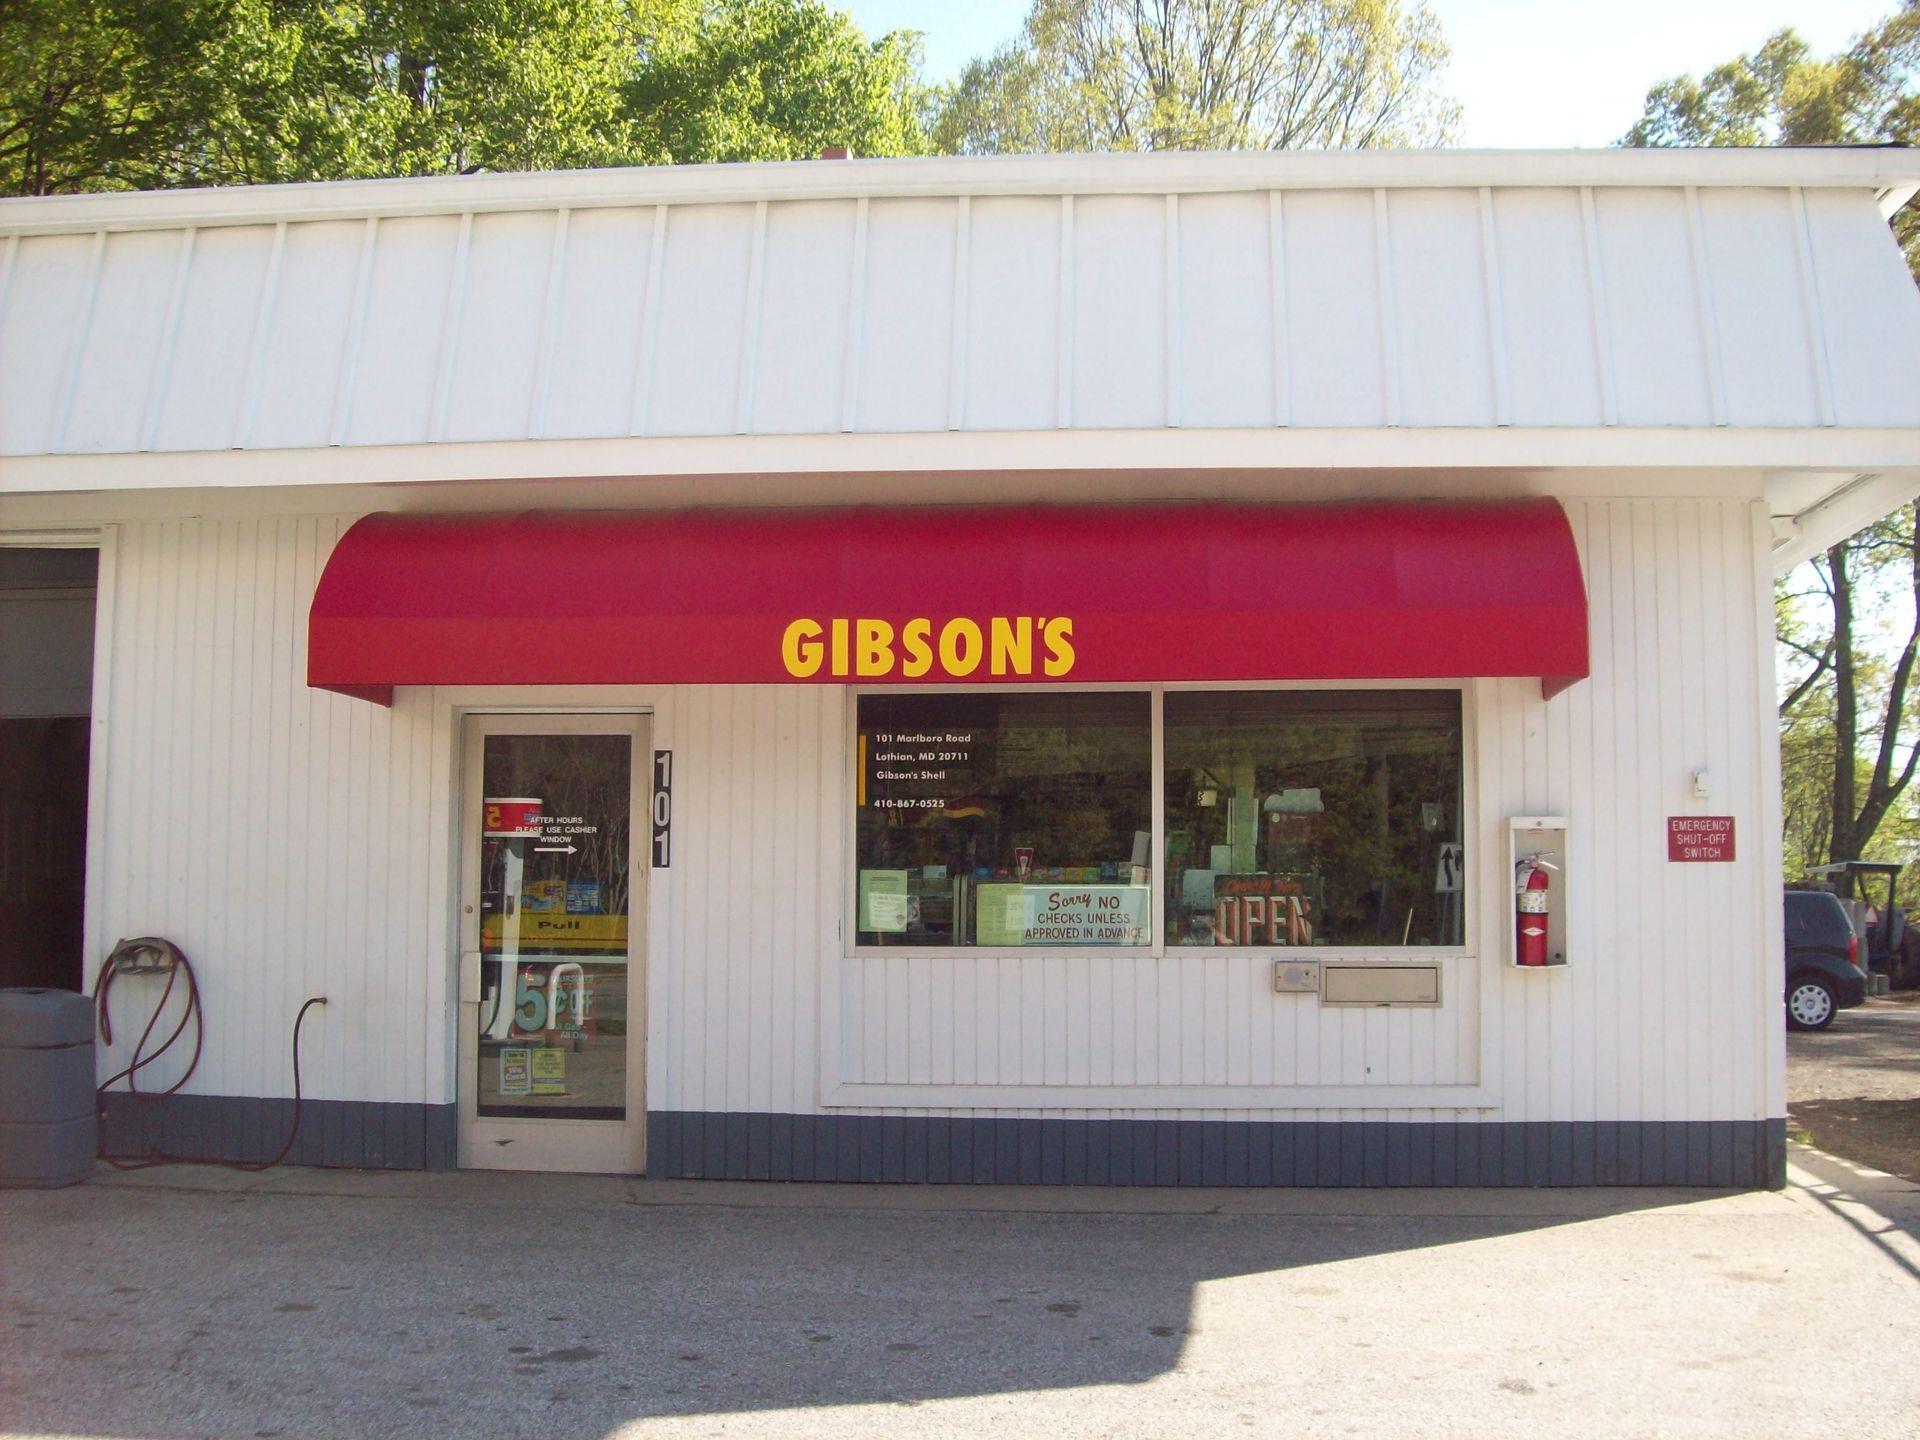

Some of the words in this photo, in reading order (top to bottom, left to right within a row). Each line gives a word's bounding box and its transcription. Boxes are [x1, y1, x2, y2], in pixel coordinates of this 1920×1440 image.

[782, 617, 1075, 677] GIBSON'S
[876, 735, 893, 743] 101
[896, 734, 942, 743] Marlboro
[945, 734, 971, 743] Road
[875, 752, 916, 762] Lothian,
[918, 752, 935, 761] MD
[938, 752, 968, 761] 20711
[876, 771, 918, 779] Gibson's
[921, 770, 945, 779] Shell
[653, 751, 670, 867] 101
[874, 799, 945, 808] 410-867-0525
[530, 816, 554, 824] AFTER
[556, 816, 583, 824] HOURS
[1672, 820, 1730, 831] EMERGENCY
[515, 826, 543, 834] PLEASE
[546, 826, 561, 834] USE
[564, 826, 597, 834] CASHIER
[540, 835, 572, 843] WINDOW
[1676, 833, 1727, 846] SHUT-OFF
[1683, 847, 1721, 859] SWITCH
[1048, 892, 1091, 911] Sorry
[1098, 895, 1120, 910] NO
[1037, 913, 1083, 925] CHECKS
[1087, 913, 1130, 925] UNLESS
[1215, 896, 1313, 946] OPEN
[538, 921, 580, 930] Pull
[1024, 927, 1080, 939] APPROVED
[1083, 927, 1093, 939] IN
[1097, 927, 1145, 939] ADVANCE
